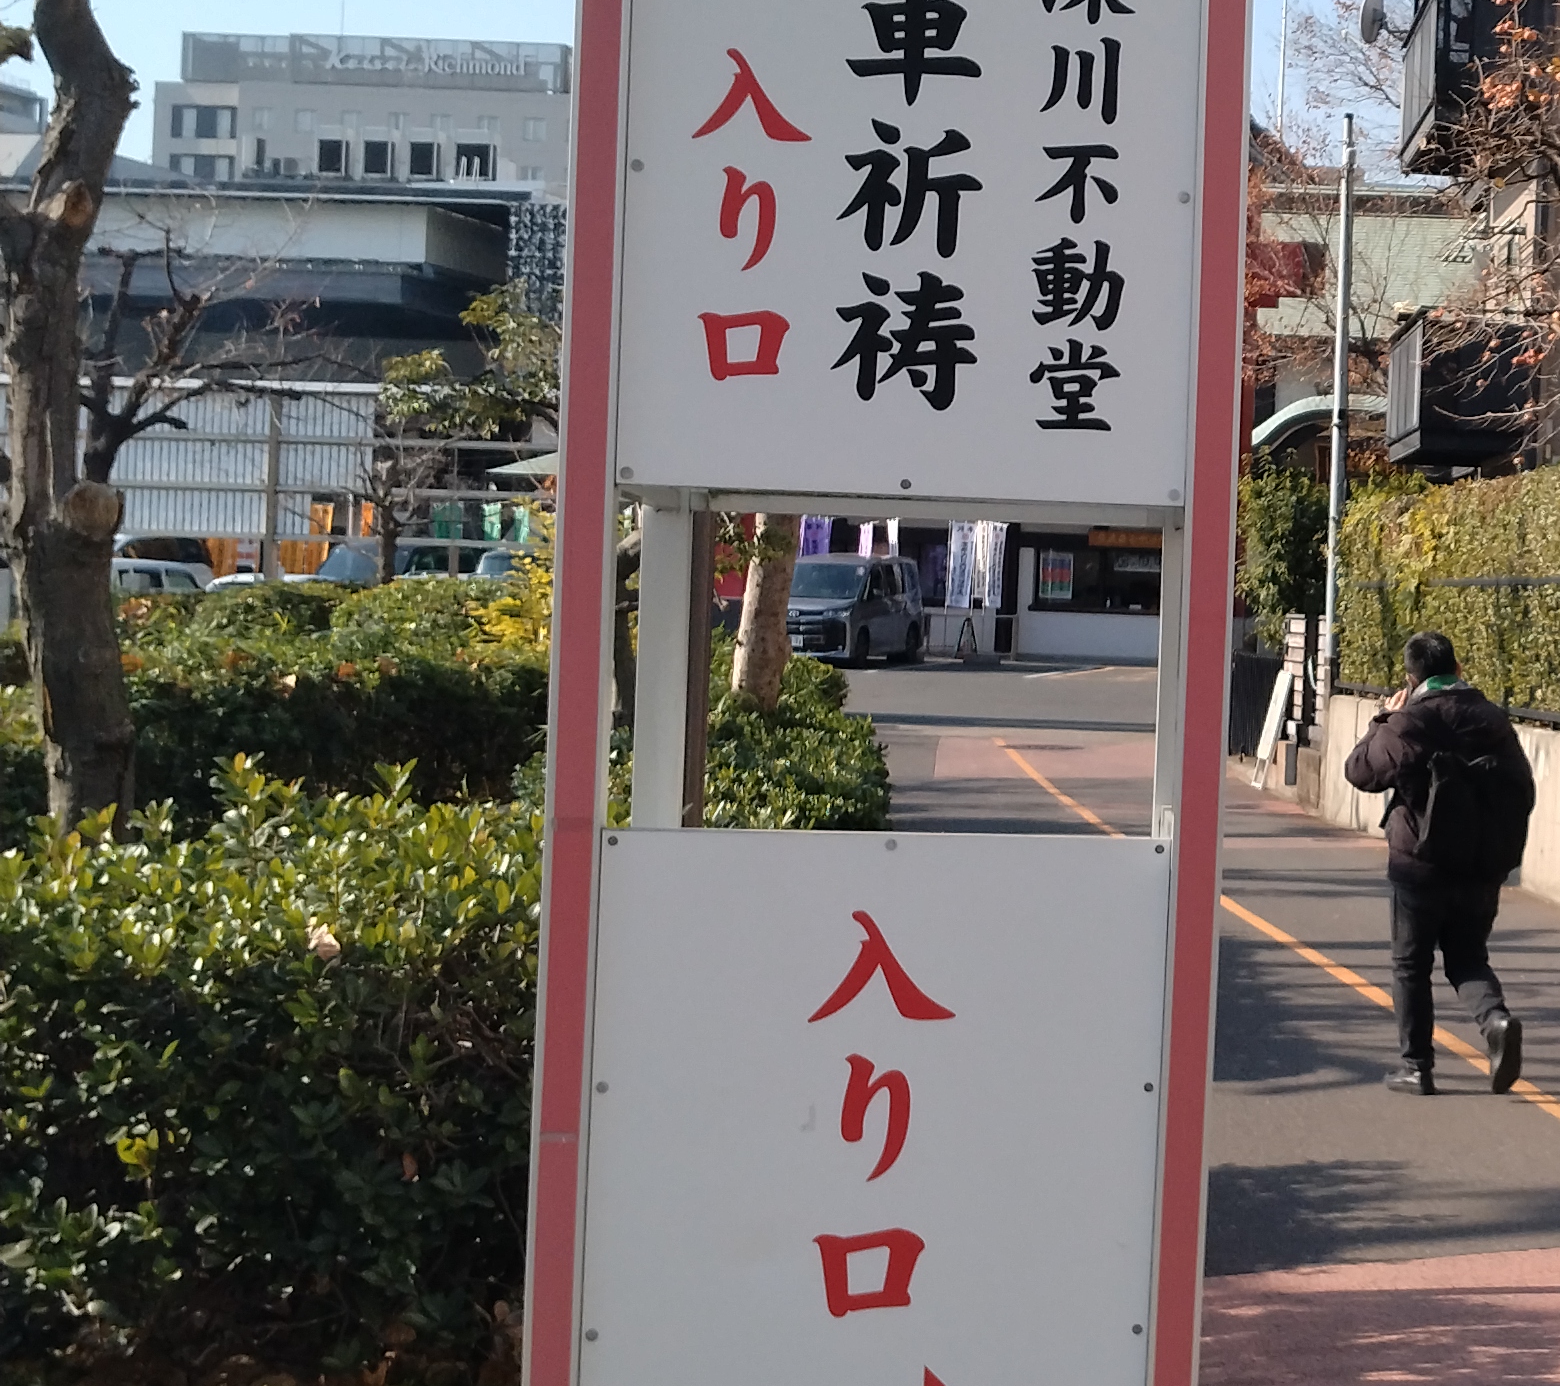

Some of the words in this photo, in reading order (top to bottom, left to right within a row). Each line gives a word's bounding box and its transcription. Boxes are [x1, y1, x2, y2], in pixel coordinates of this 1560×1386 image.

[424, 52, 526, 76] Richmond
[692, 48, 812, 382] 入り口
[808, 910, 956, 1318] 入り口
